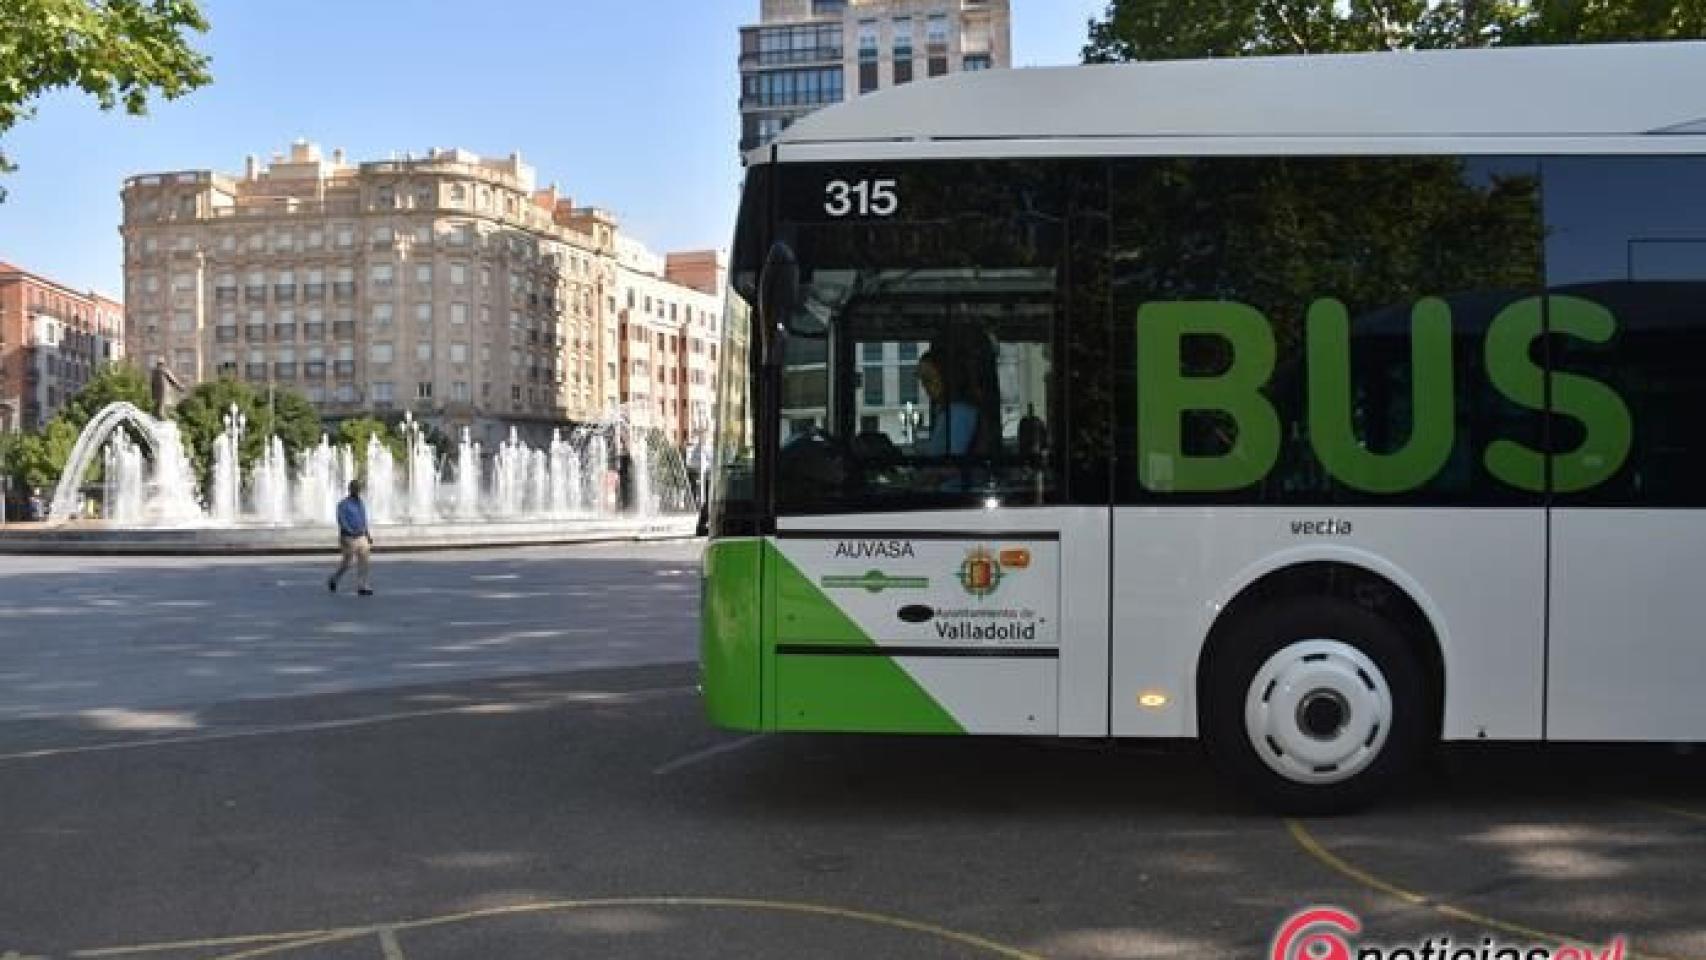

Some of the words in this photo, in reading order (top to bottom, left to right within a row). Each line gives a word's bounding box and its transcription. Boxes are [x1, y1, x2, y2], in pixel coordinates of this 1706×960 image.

[824, 179, 898, 216] 315
[1137, 296, 1633, 493] BUS
[1290, 518, 1353, 536] vectia
[834, 540, 915, 558] AUVASA
[935, 621, 1036, 640] Valladolid
